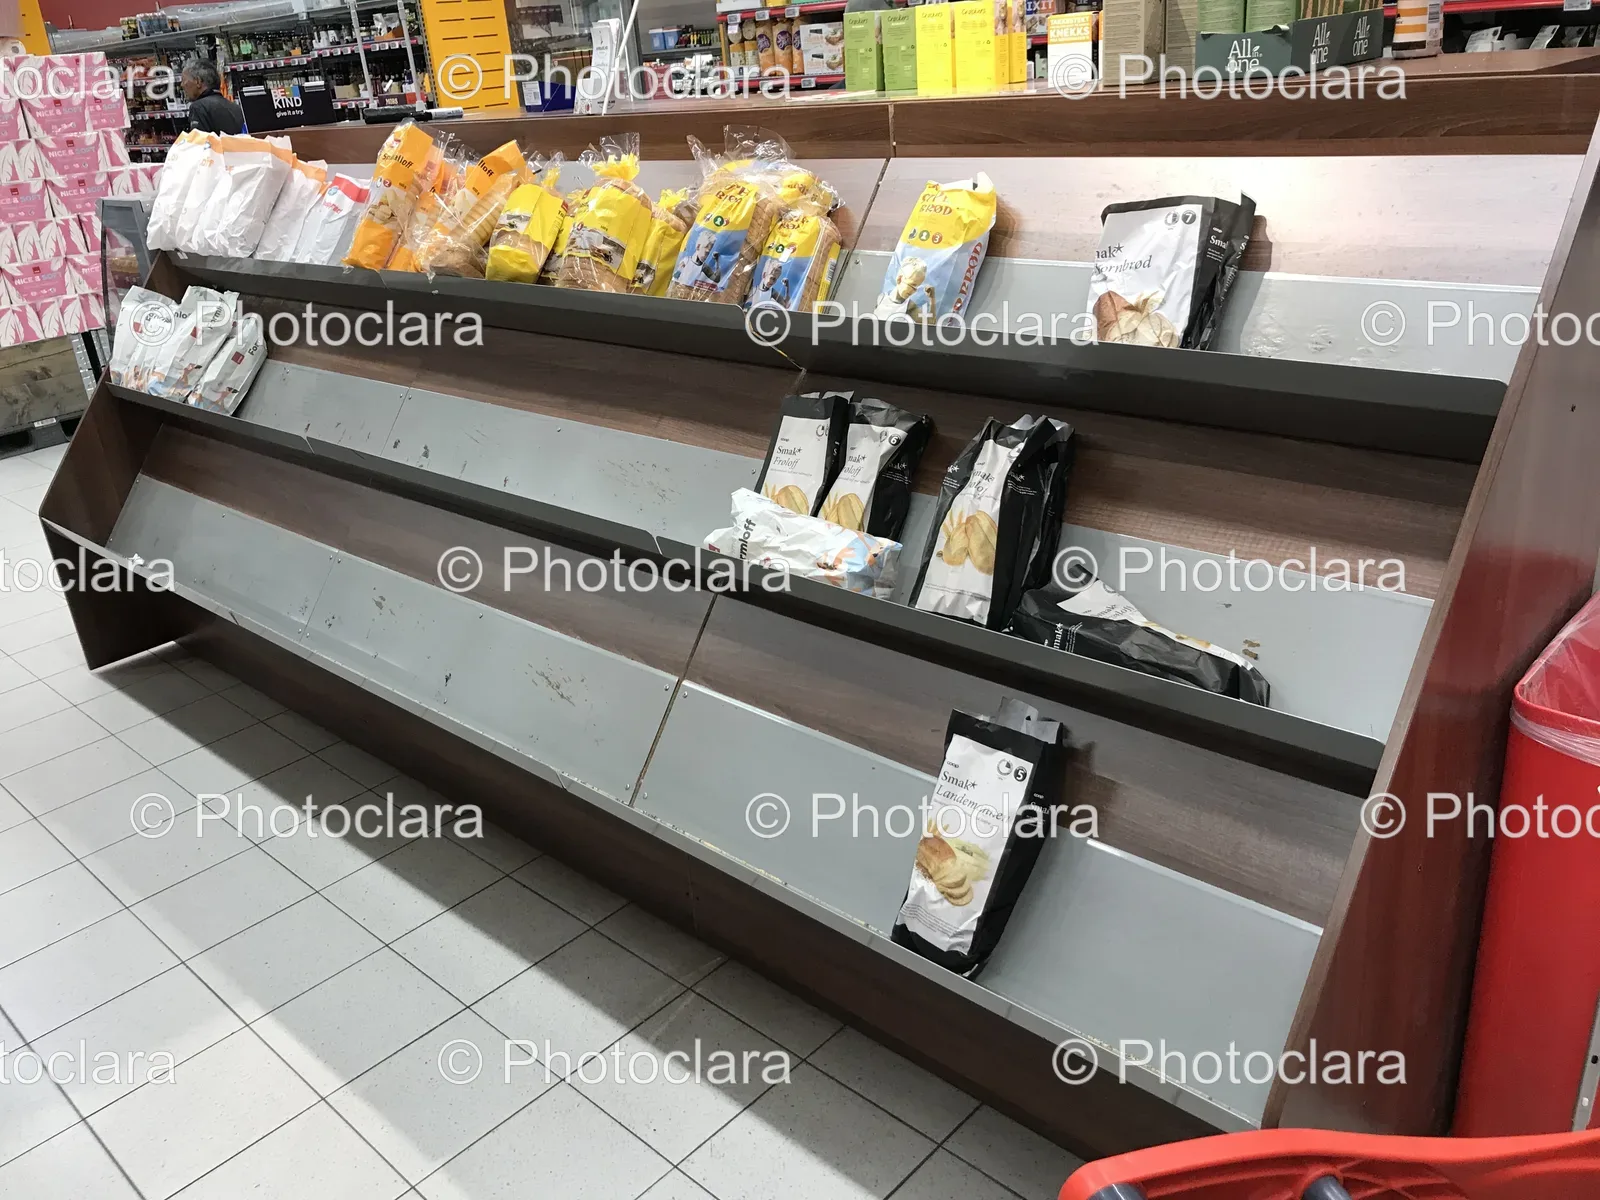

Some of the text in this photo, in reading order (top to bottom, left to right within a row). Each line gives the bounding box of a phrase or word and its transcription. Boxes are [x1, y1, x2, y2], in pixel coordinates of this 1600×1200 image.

[1049, 26, 1090, 38] KNEKKS
[1228, 38, 1252, 59] All
[1353, 39, 1369, 56] one
[1312, 46, 1329, 64] one
[1227, 57, 1260, 73] one
[273, 96, 303, 110] KIND
[36, 109, 55, 118] NICE
[62, 105, 83, 115] SOFT
[48, 149, 68, 158] NICE
[75, 146, 97, 155] SOFT
[60, 184, 107, 198] NICE & SOFT
[15, 271, 62, 286] NICE & SOFT
